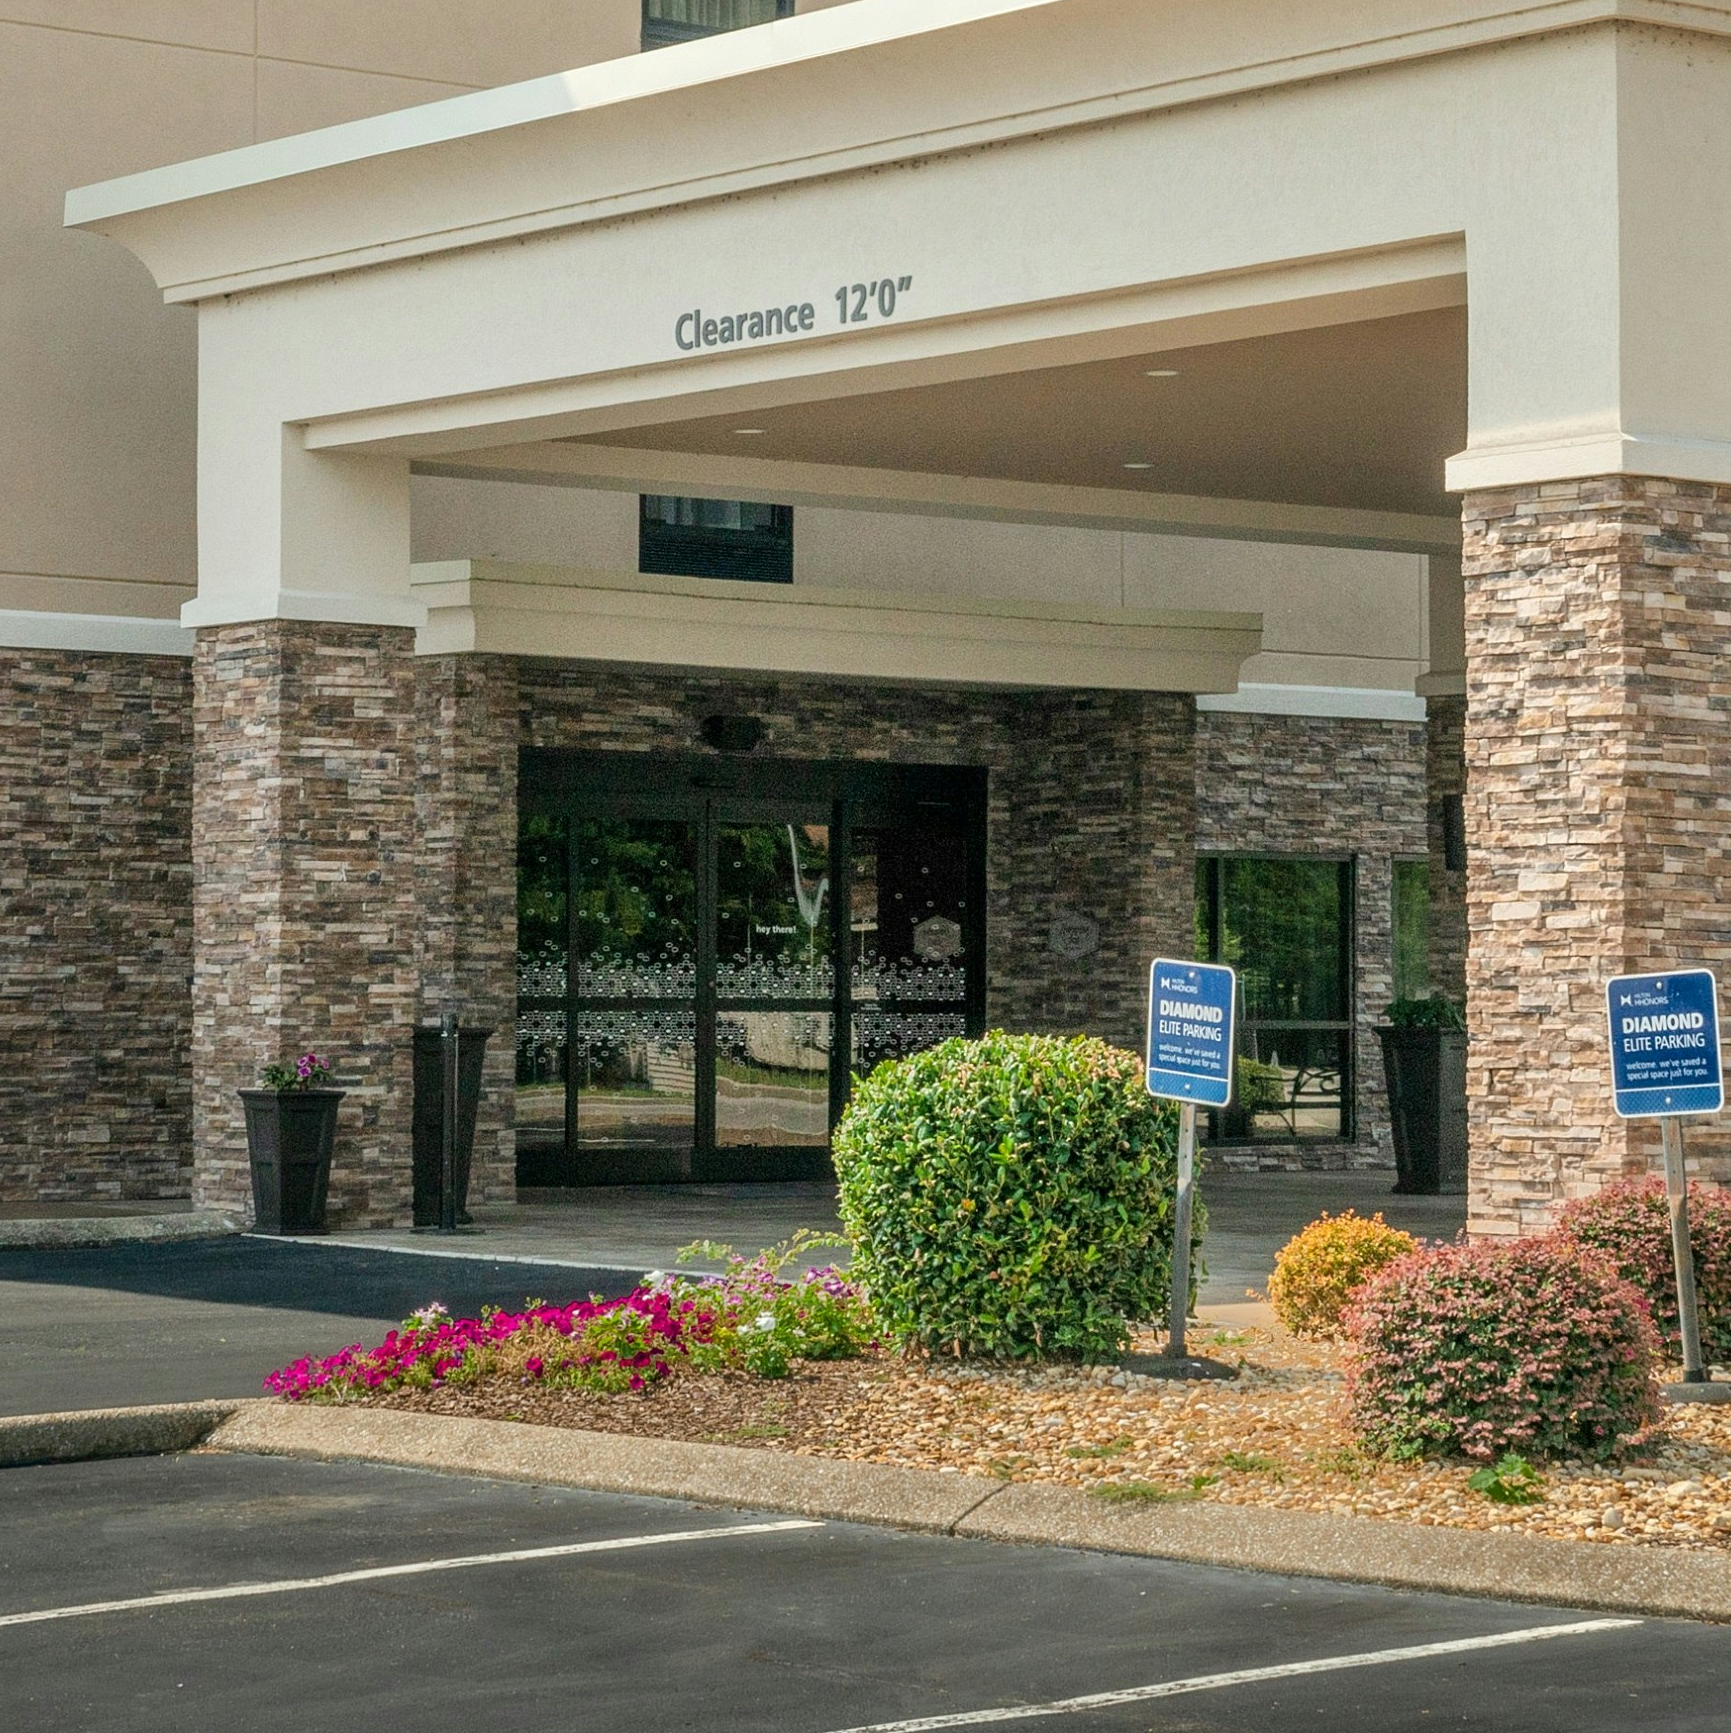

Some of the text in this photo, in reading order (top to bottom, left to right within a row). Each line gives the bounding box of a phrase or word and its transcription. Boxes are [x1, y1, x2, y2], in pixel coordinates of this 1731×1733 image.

[675, 309, 815, 350] Clearance
[755, 924, 797, 935] hey there!
[1171, 984, 1198, 994] HHONORS
[1634, 996, 1669, 1006] HHONORS
[1160, 999, 1223, 1023] DIAMOND
[1159, 1019, 1222, 1042] ELITE PARKING
[1622, 1012, 1704, 1034] DIAMOND
[1623, 1032, 1706, 1053] ELITE PARKING
[1626, 1061, 1658, 1070] welcome.
[1659, 1059, 1680, 1068] we've
[1681, 1056, 1700, 1066] saved
[1627, 1067, 1709, 1082] special space just for you.
